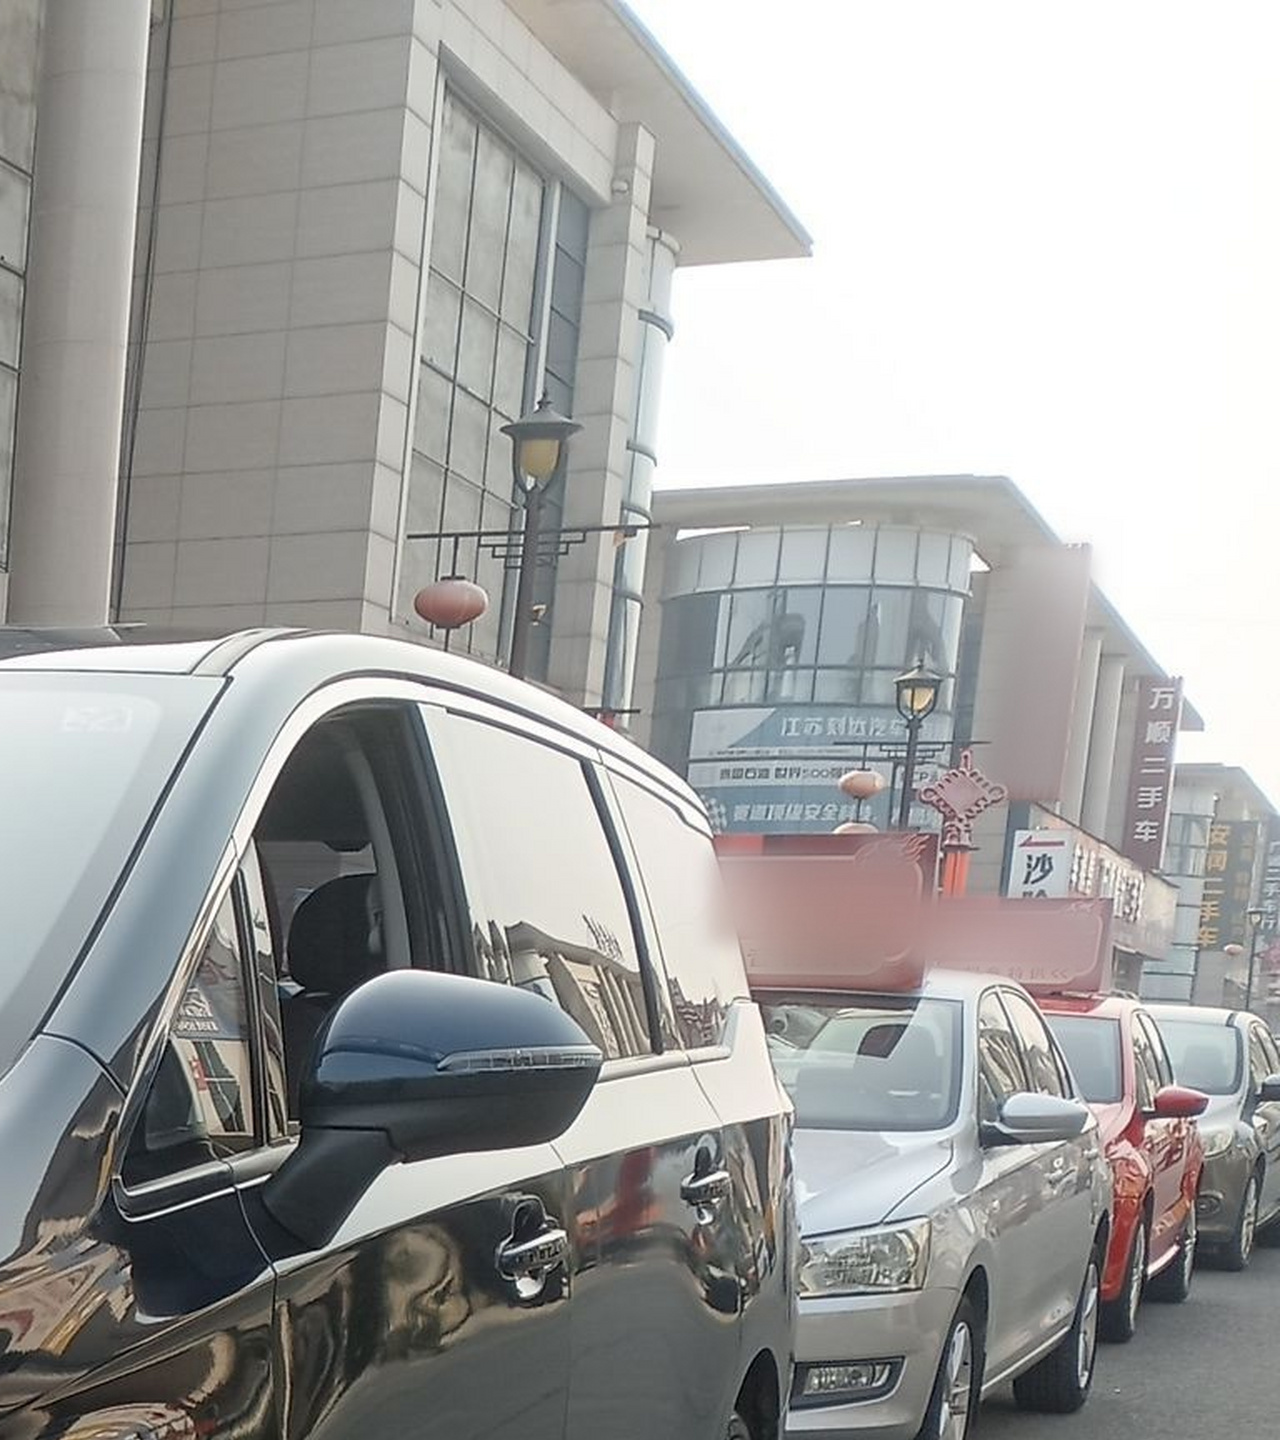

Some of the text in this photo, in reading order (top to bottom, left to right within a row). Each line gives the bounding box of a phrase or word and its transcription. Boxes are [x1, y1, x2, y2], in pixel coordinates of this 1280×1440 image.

[1133, 686, 1175, 842] 万顺二手车
